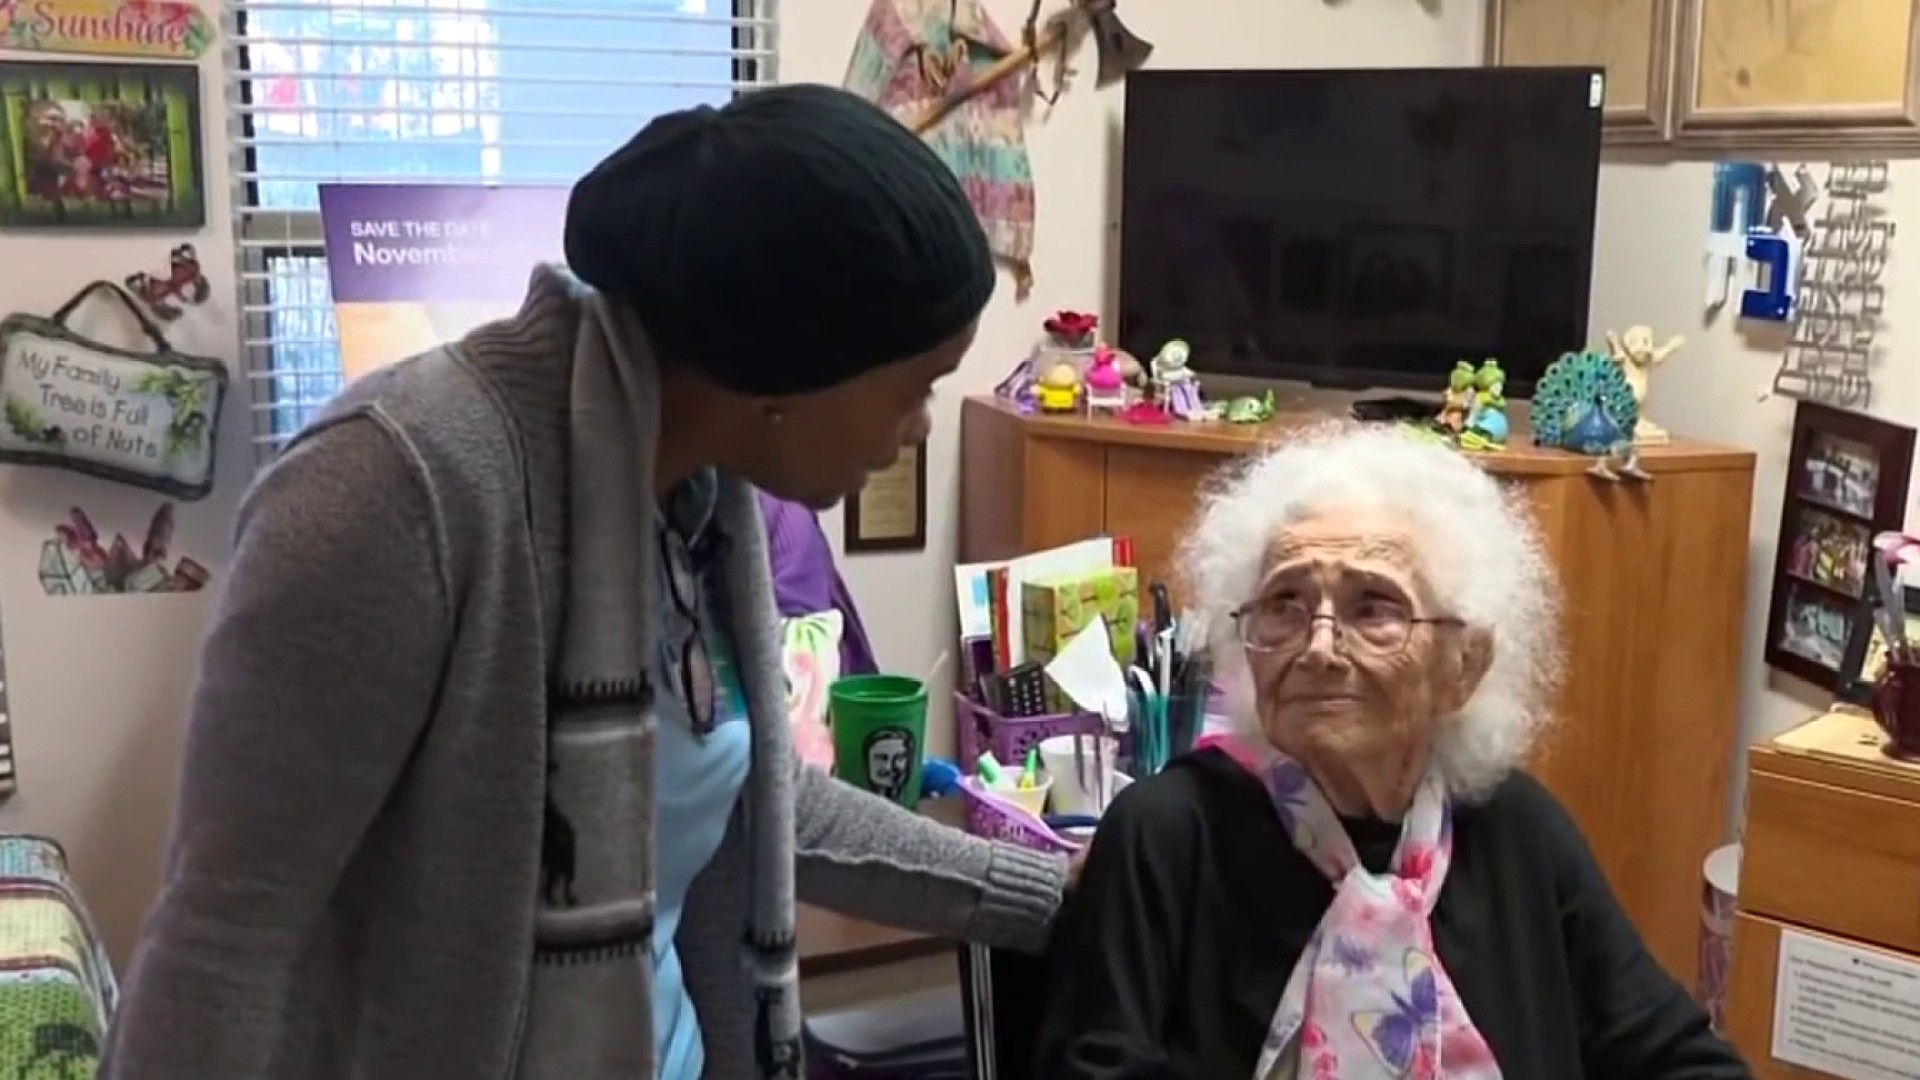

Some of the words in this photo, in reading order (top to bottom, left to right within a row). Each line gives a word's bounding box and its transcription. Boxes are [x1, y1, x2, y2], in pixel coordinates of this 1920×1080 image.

[29, 1, 186, 50] Sunshine
[350, 221, 400, 237] SAVE
[402, 221, 441, 237] THE
[444, 221, 491, 237] DATE
[18, 351, 49, 380] My
[52, 356, 120, 396] Family
[39, 383, 87, 415] Tree
[89, 396, 108, 420] is
[112, 399, 149, 427] Full
[73, 424, 102, 447] of
[106, 427, 157, 458] Nuts
